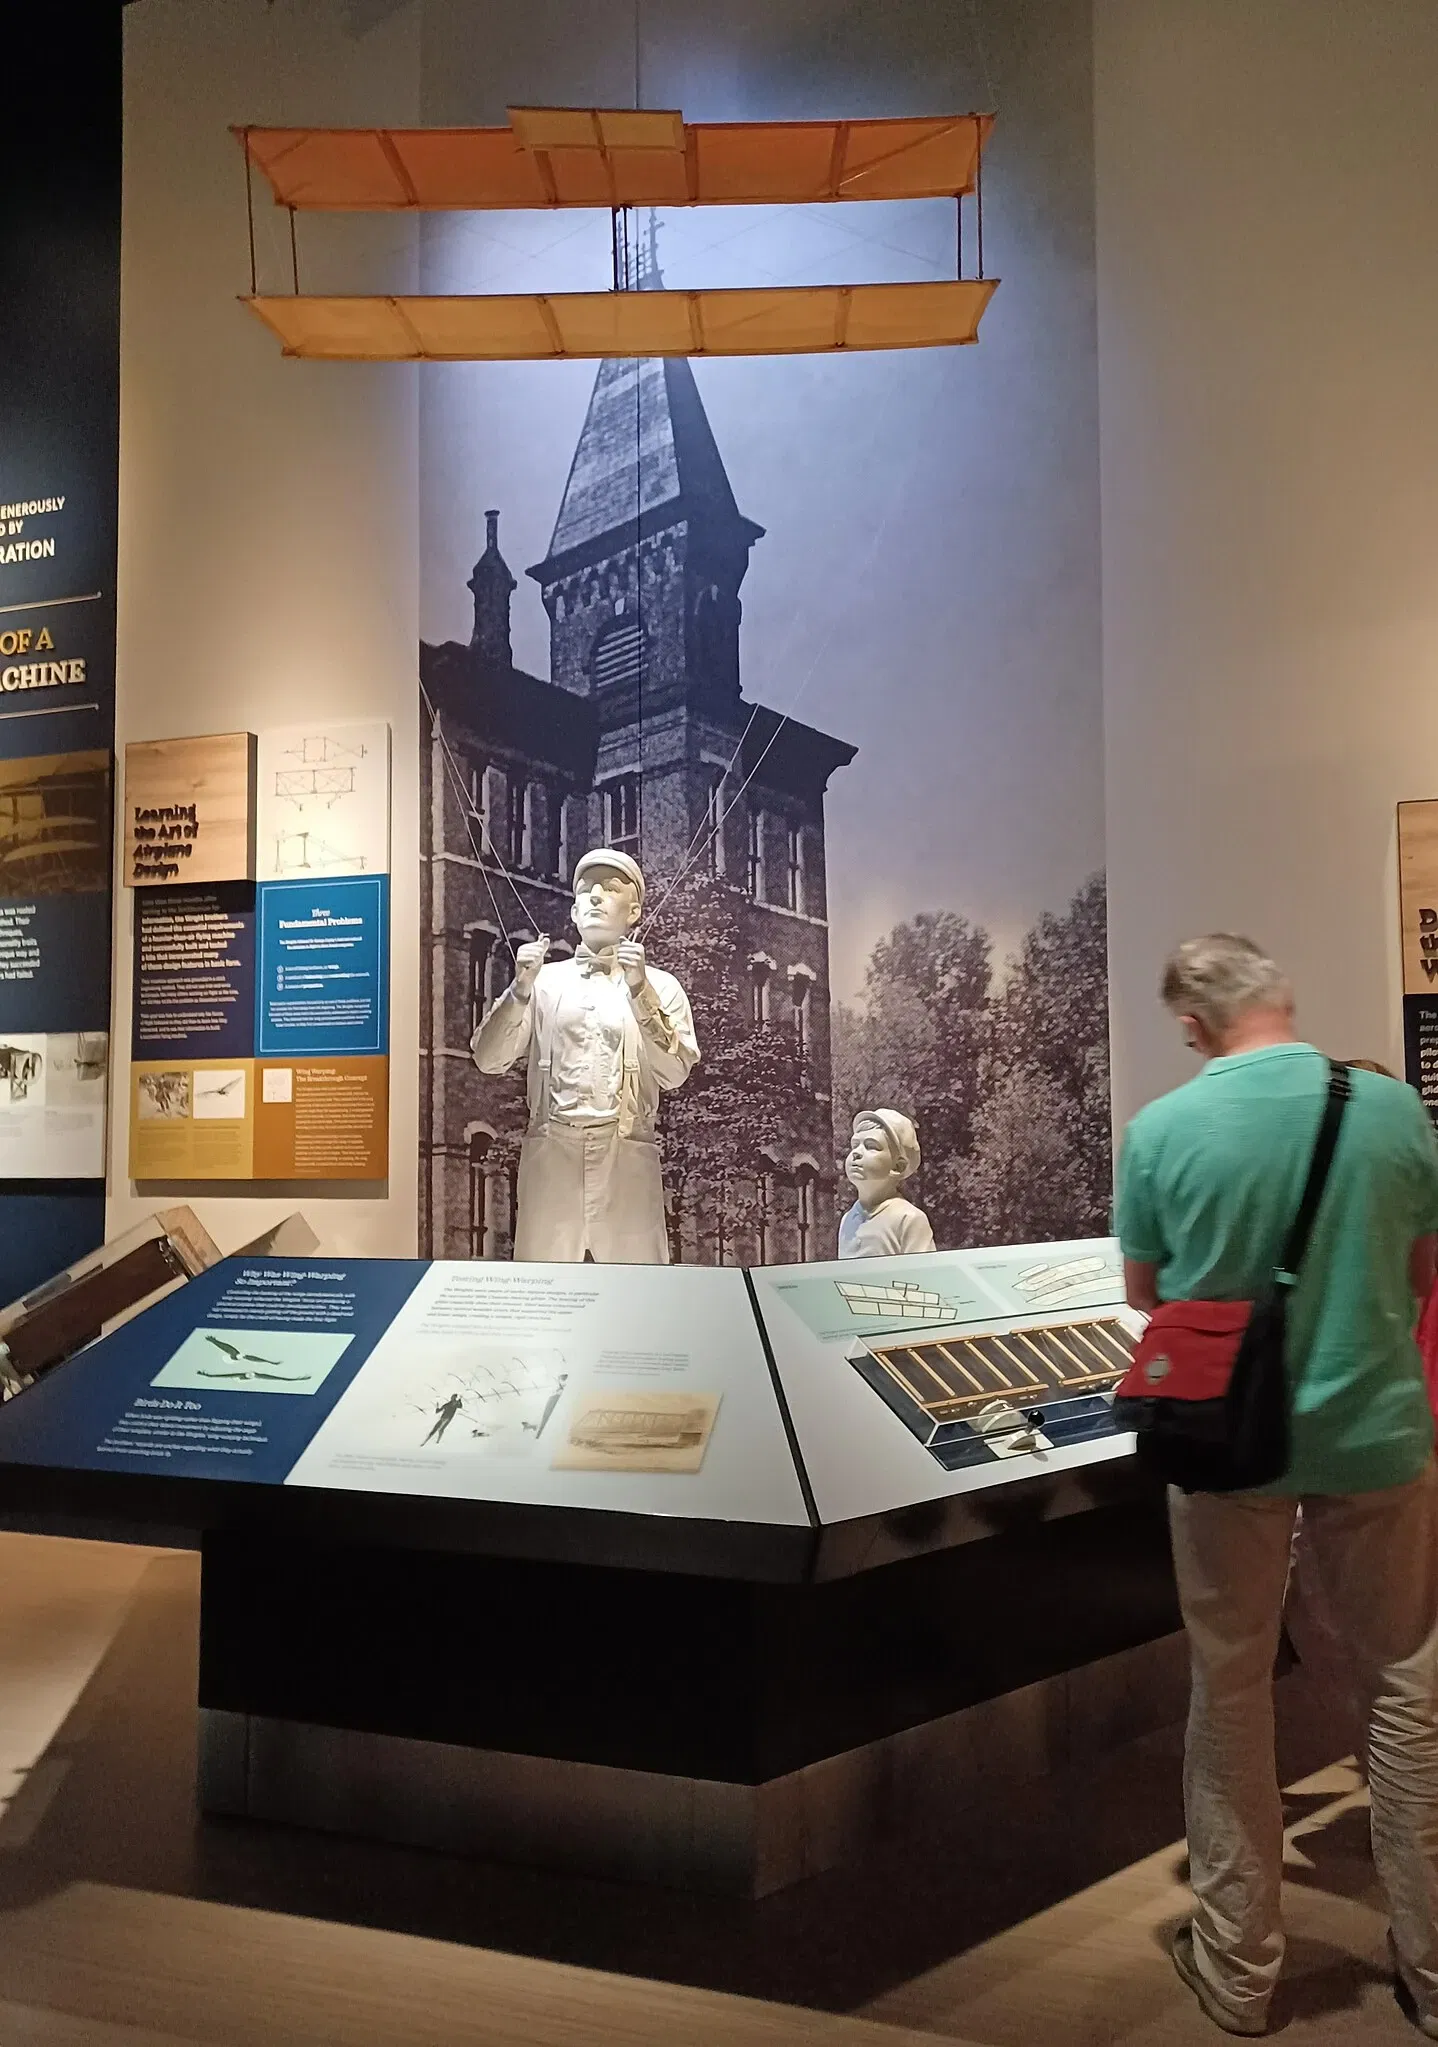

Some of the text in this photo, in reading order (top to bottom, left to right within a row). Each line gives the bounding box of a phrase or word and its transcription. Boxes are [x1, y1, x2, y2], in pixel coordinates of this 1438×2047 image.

[0, 496, 65, 519] ENEROUSLY
[8, 520, 24, 535] BY
[0, 627, 55, 656] OF A
[0, 657, 86, 692] CHINE
[135, 803, 196, 823] Learning
[158, 824, 181, 840] Art
[184, 821, 199, 838] of
[328, 917, 363, 927] Problems
